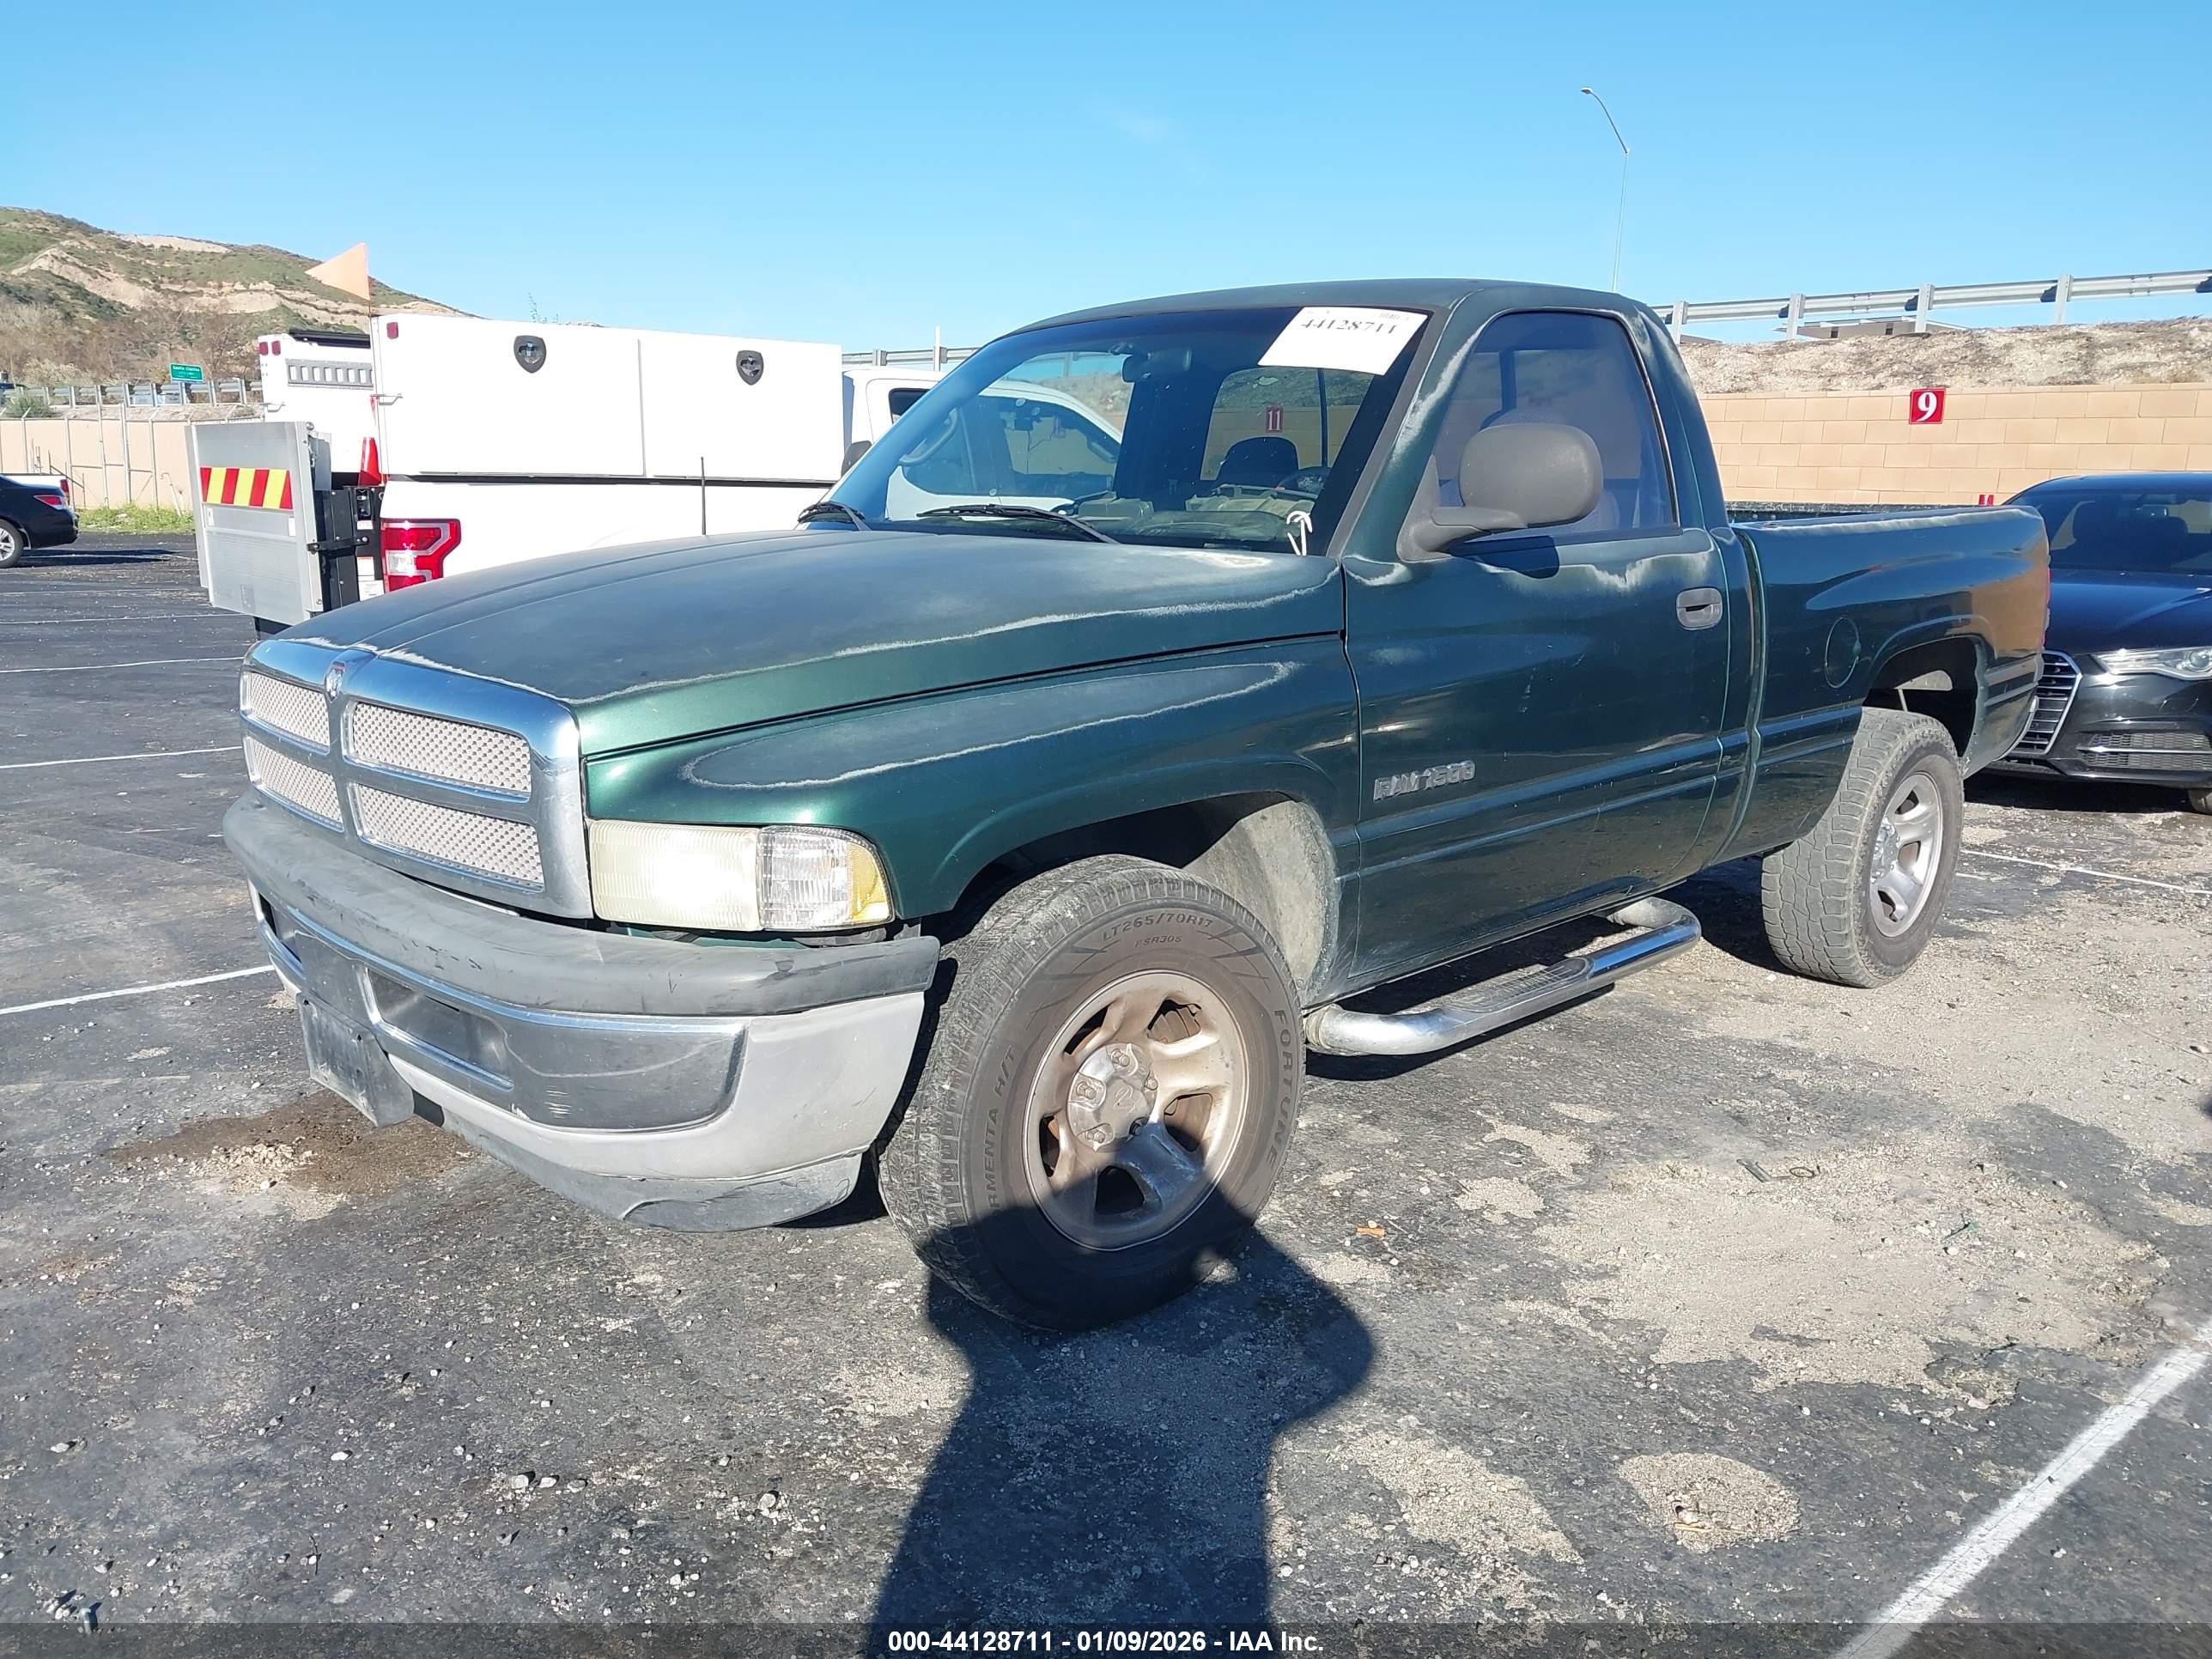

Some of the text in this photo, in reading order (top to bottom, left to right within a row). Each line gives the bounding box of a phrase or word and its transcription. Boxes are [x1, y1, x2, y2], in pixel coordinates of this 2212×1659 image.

[1301, 319, 1397, 334] 44128711
[1267, 410, 1280, 430] 11
[1917, 392, 1937, 422] 9
[1374, 771, 1419, 800] RAM
[1103, 912, 1213, 942] LT265/70R17
[1267, 1010, 1293, 1167] FORTUNE
